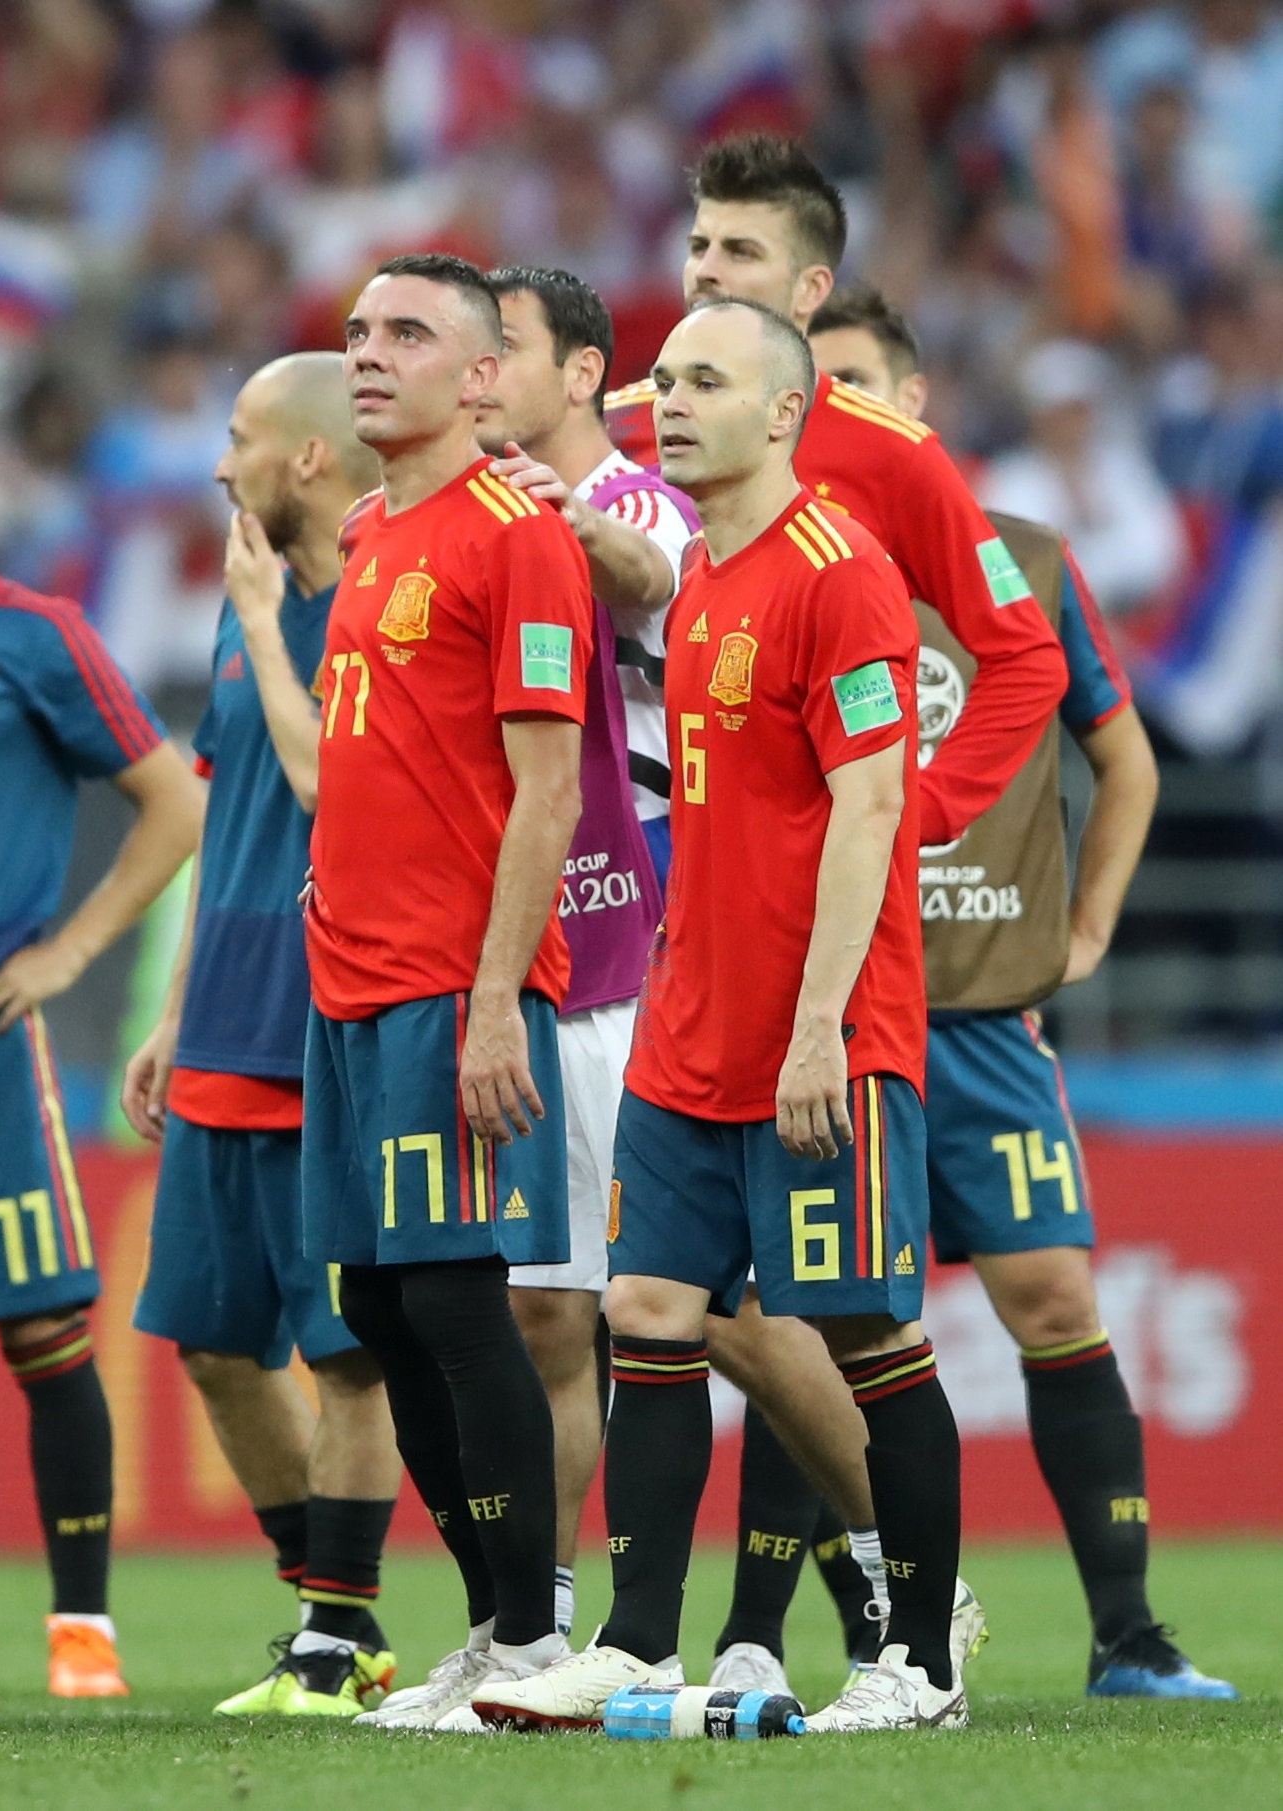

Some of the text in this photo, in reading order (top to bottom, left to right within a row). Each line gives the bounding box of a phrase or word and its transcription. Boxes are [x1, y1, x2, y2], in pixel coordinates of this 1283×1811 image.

[325, 651, 371, 739] 17
[680, 712, 706, 805] 6
[576, 852, 609, 873] CUP
[579, 870, 641, 913] 201
[956, 884, 1023, 921] 2018
[381, 1133, 446, 1229] 17
[991, 1129, 1078, 1220] 14
[790, 1188, 840, 1281] 6
[747, 1529, 801, 1561] RFEF
